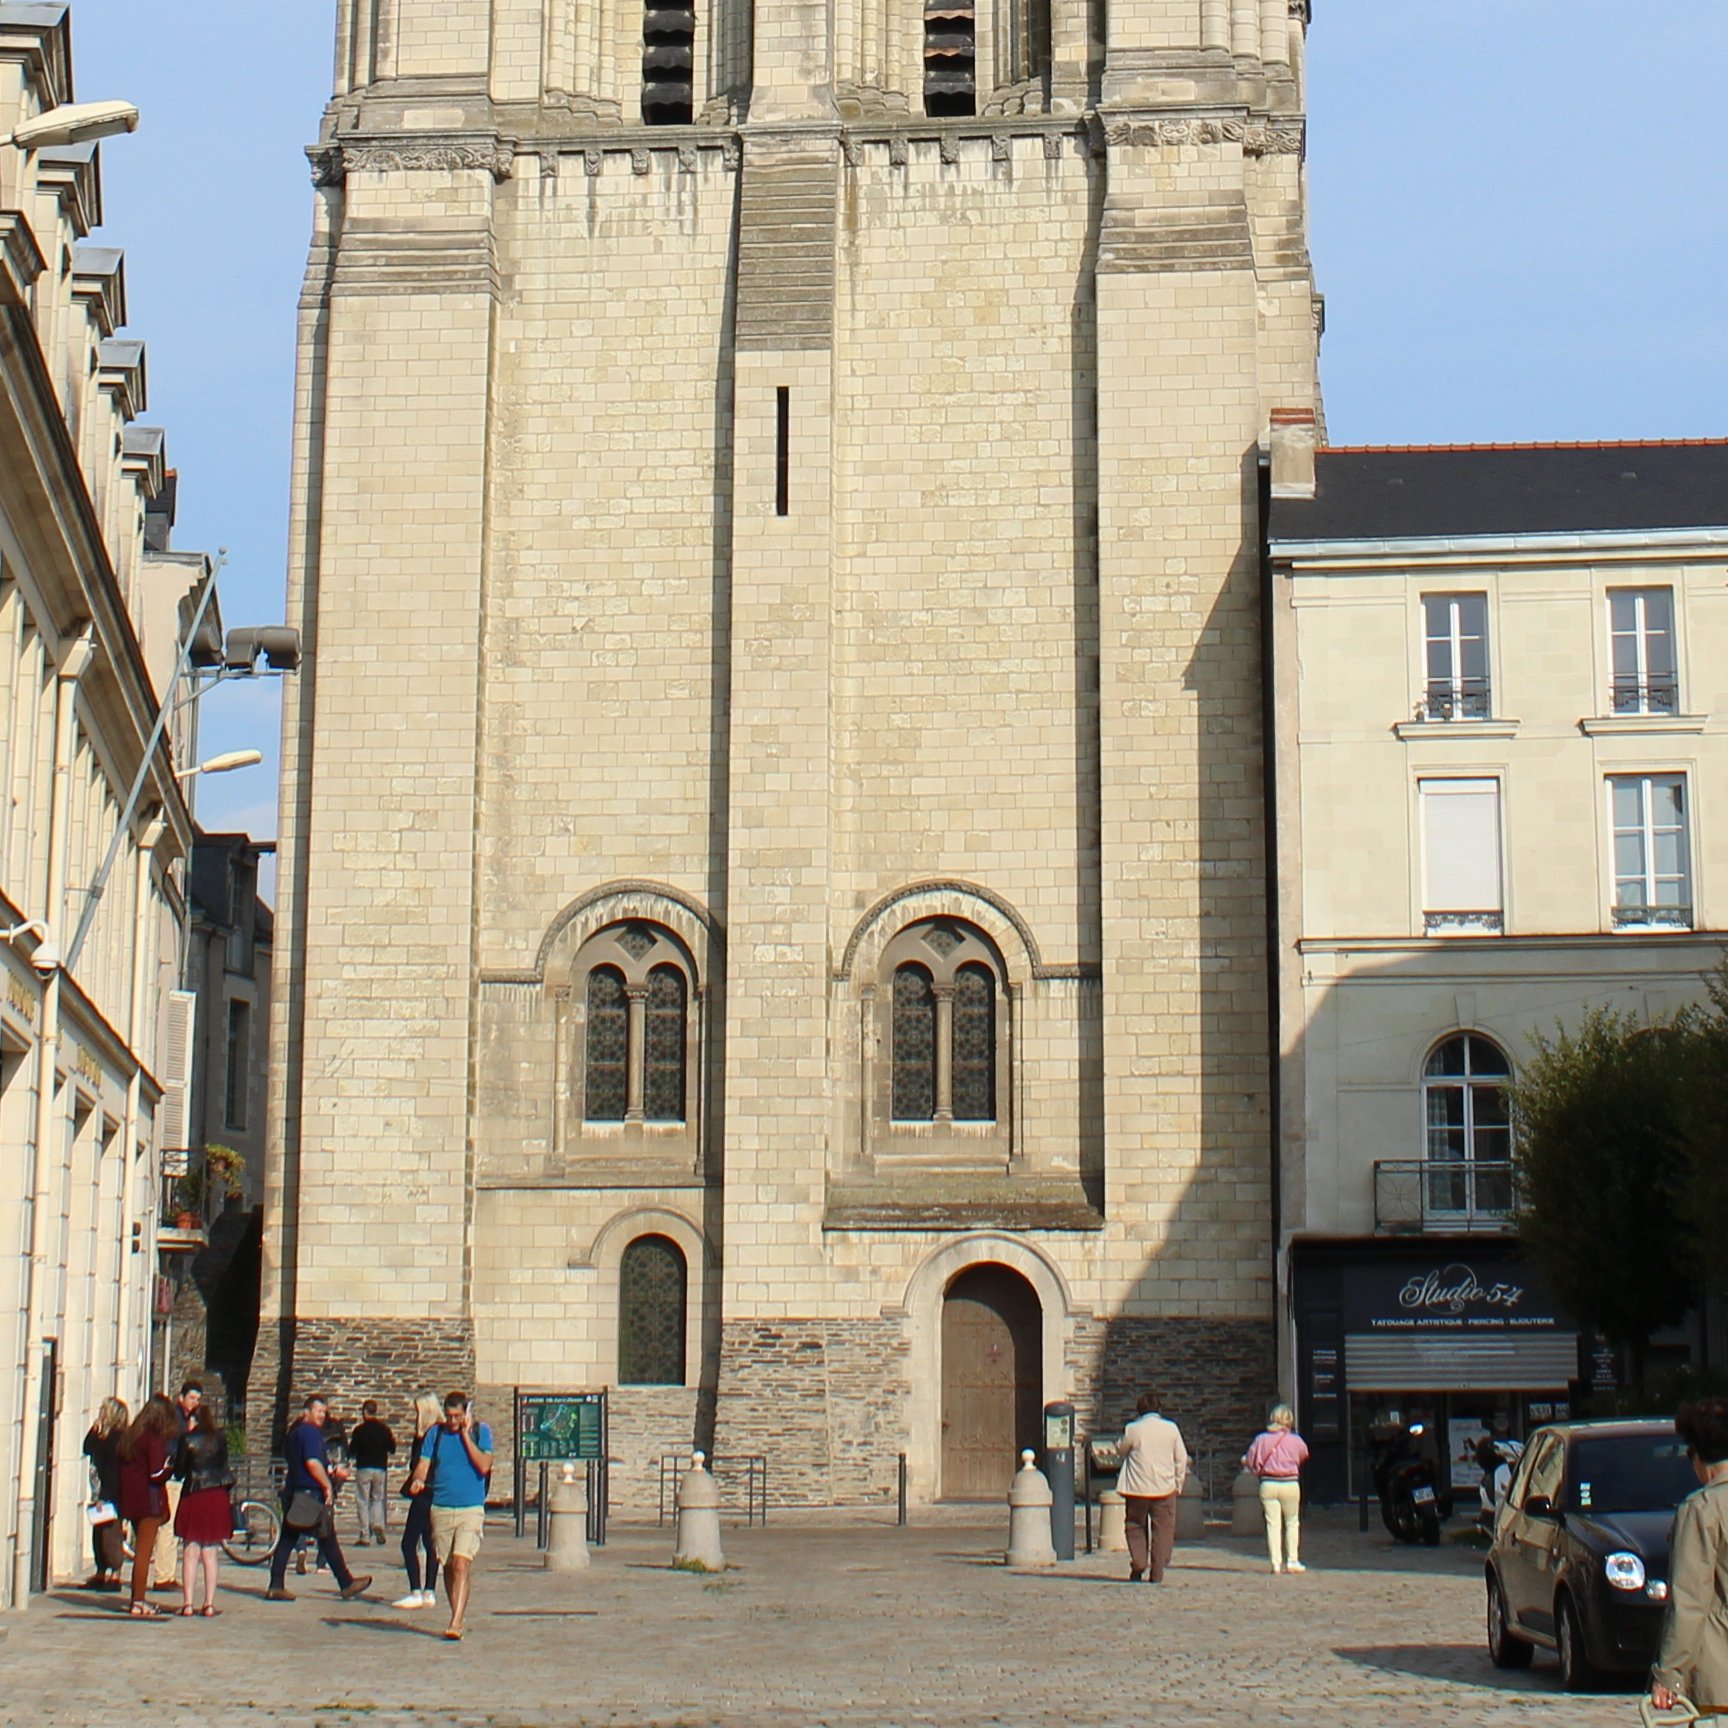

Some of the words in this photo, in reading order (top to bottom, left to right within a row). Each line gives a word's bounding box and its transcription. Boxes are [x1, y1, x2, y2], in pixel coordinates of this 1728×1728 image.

[1399, 1263, 1485, 1315] Studio
[1486, 1282, 1523, 1307] 54
[1371, 1318, 1414, 1327] TATOUAGE
[1416, 1318, 1463, 1327] ARTISTIQUE
[1468, 1318, 1504, 1327] PIERCING
[1510, 1318, 1555, 1326] BIJOUTERIE
